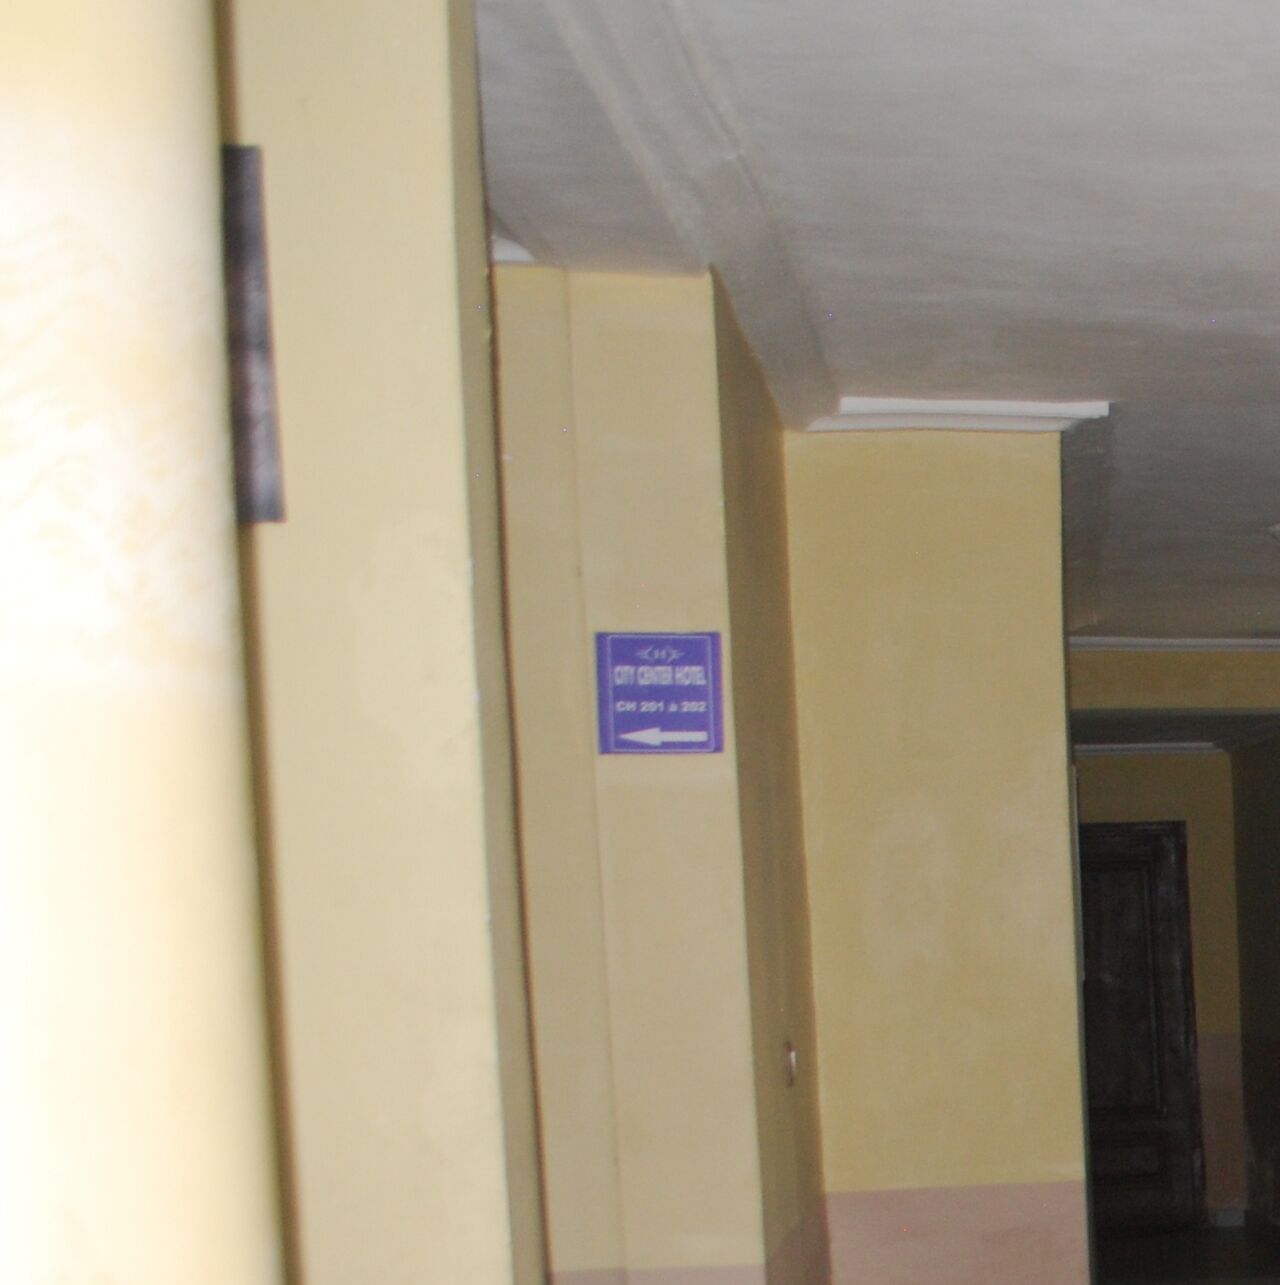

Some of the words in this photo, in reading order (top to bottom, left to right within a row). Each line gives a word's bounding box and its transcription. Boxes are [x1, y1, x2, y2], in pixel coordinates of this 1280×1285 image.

[614, 665, 636, 685] CITY
[638, 665, 673, 685] CENTER
[675, 665, 707, 685] HOTEL
[616, 701, 637, 712] CH
